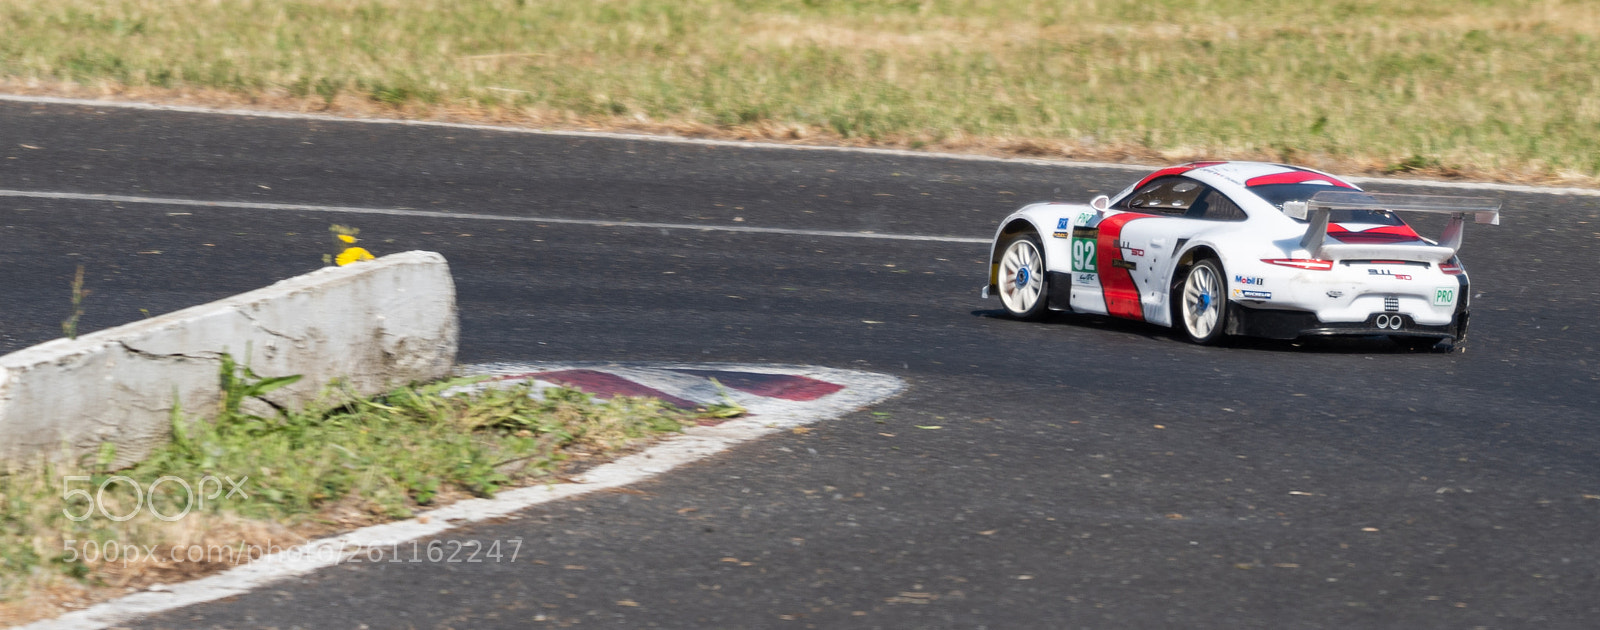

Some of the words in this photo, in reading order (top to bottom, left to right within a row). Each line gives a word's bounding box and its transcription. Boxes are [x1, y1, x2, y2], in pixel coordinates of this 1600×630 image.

[1073, 240, 1096, 271] 92
[1235, 275, 1255, 284] Mobil
[1436, 289, 1453, 303] PRO
